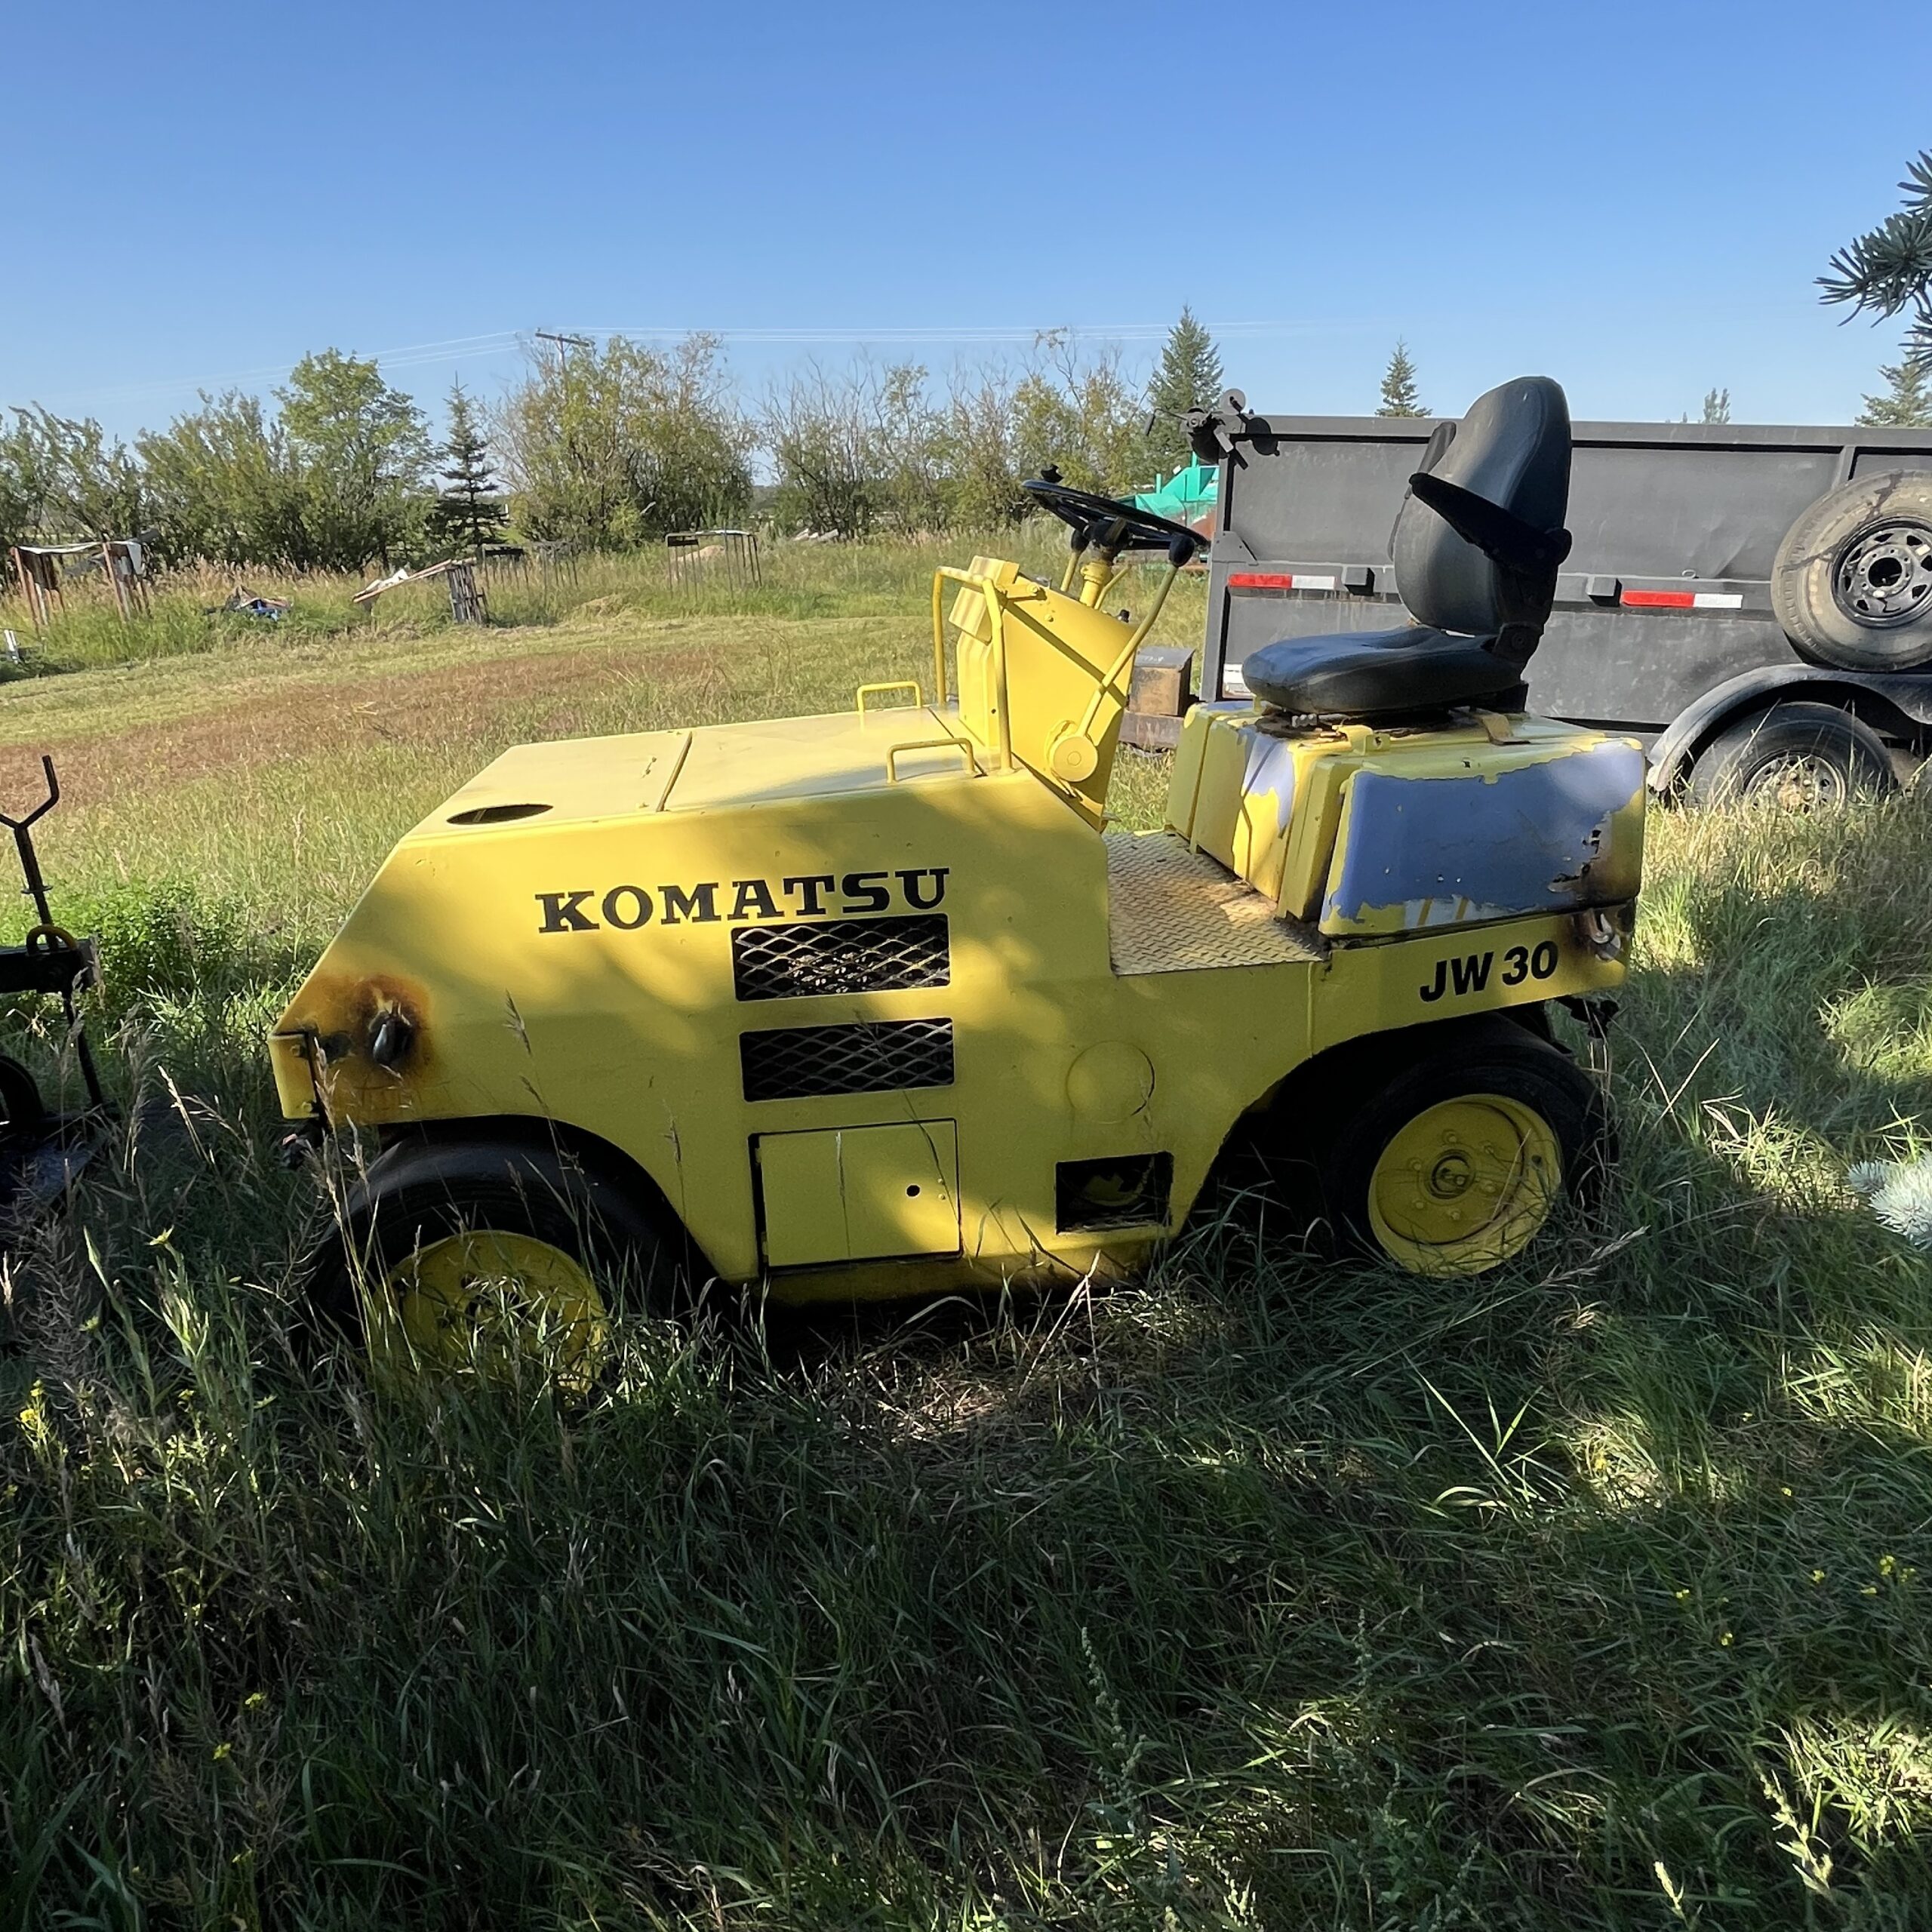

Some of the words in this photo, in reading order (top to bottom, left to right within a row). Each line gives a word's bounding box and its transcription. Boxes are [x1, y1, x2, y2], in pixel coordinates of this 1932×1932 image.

[534, 867, 949, 934] KOMATSU
[1420, 952, 1494, 1002] JW
[1502, 940, 1558, 986] 30
